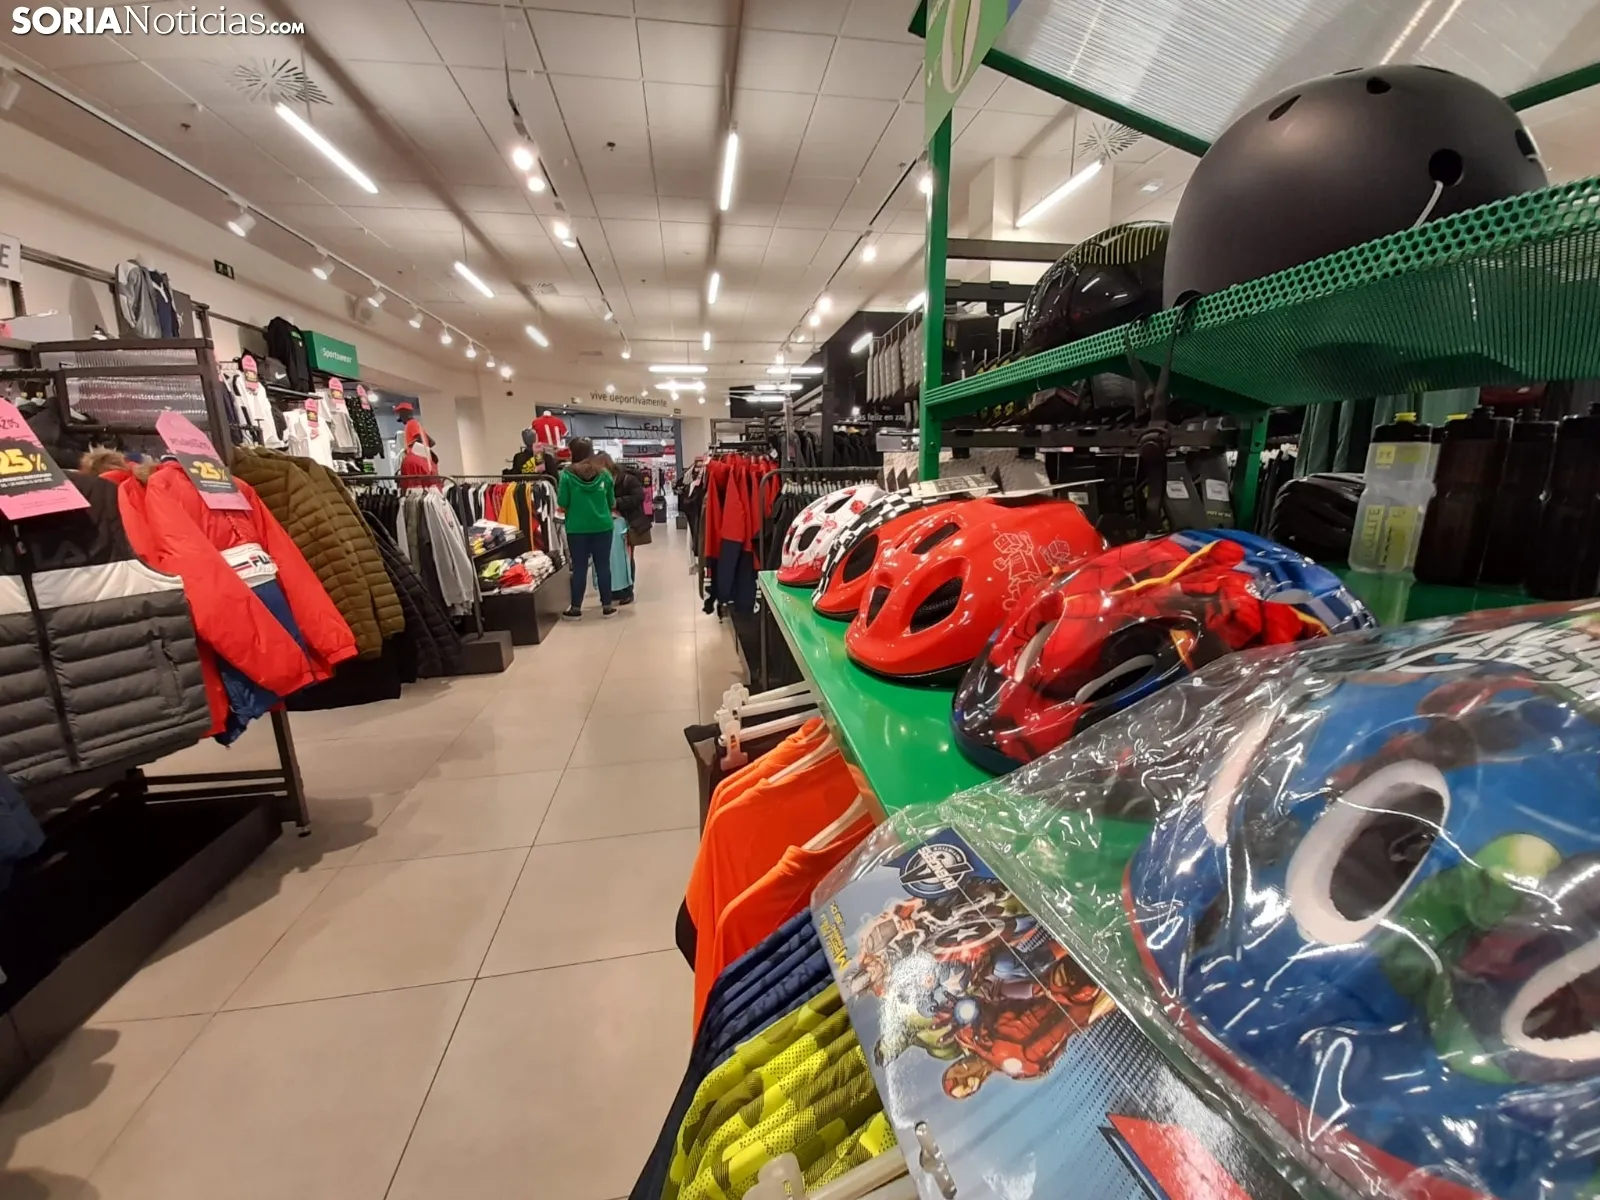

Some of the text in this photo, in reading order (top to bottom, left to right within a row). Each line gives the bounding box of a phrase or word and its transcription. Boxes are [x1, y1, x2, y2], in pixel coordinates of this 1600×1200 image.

[322, 347, 352, 364] Sportswear
[590, 391, 668, 407] vive deportivamente
